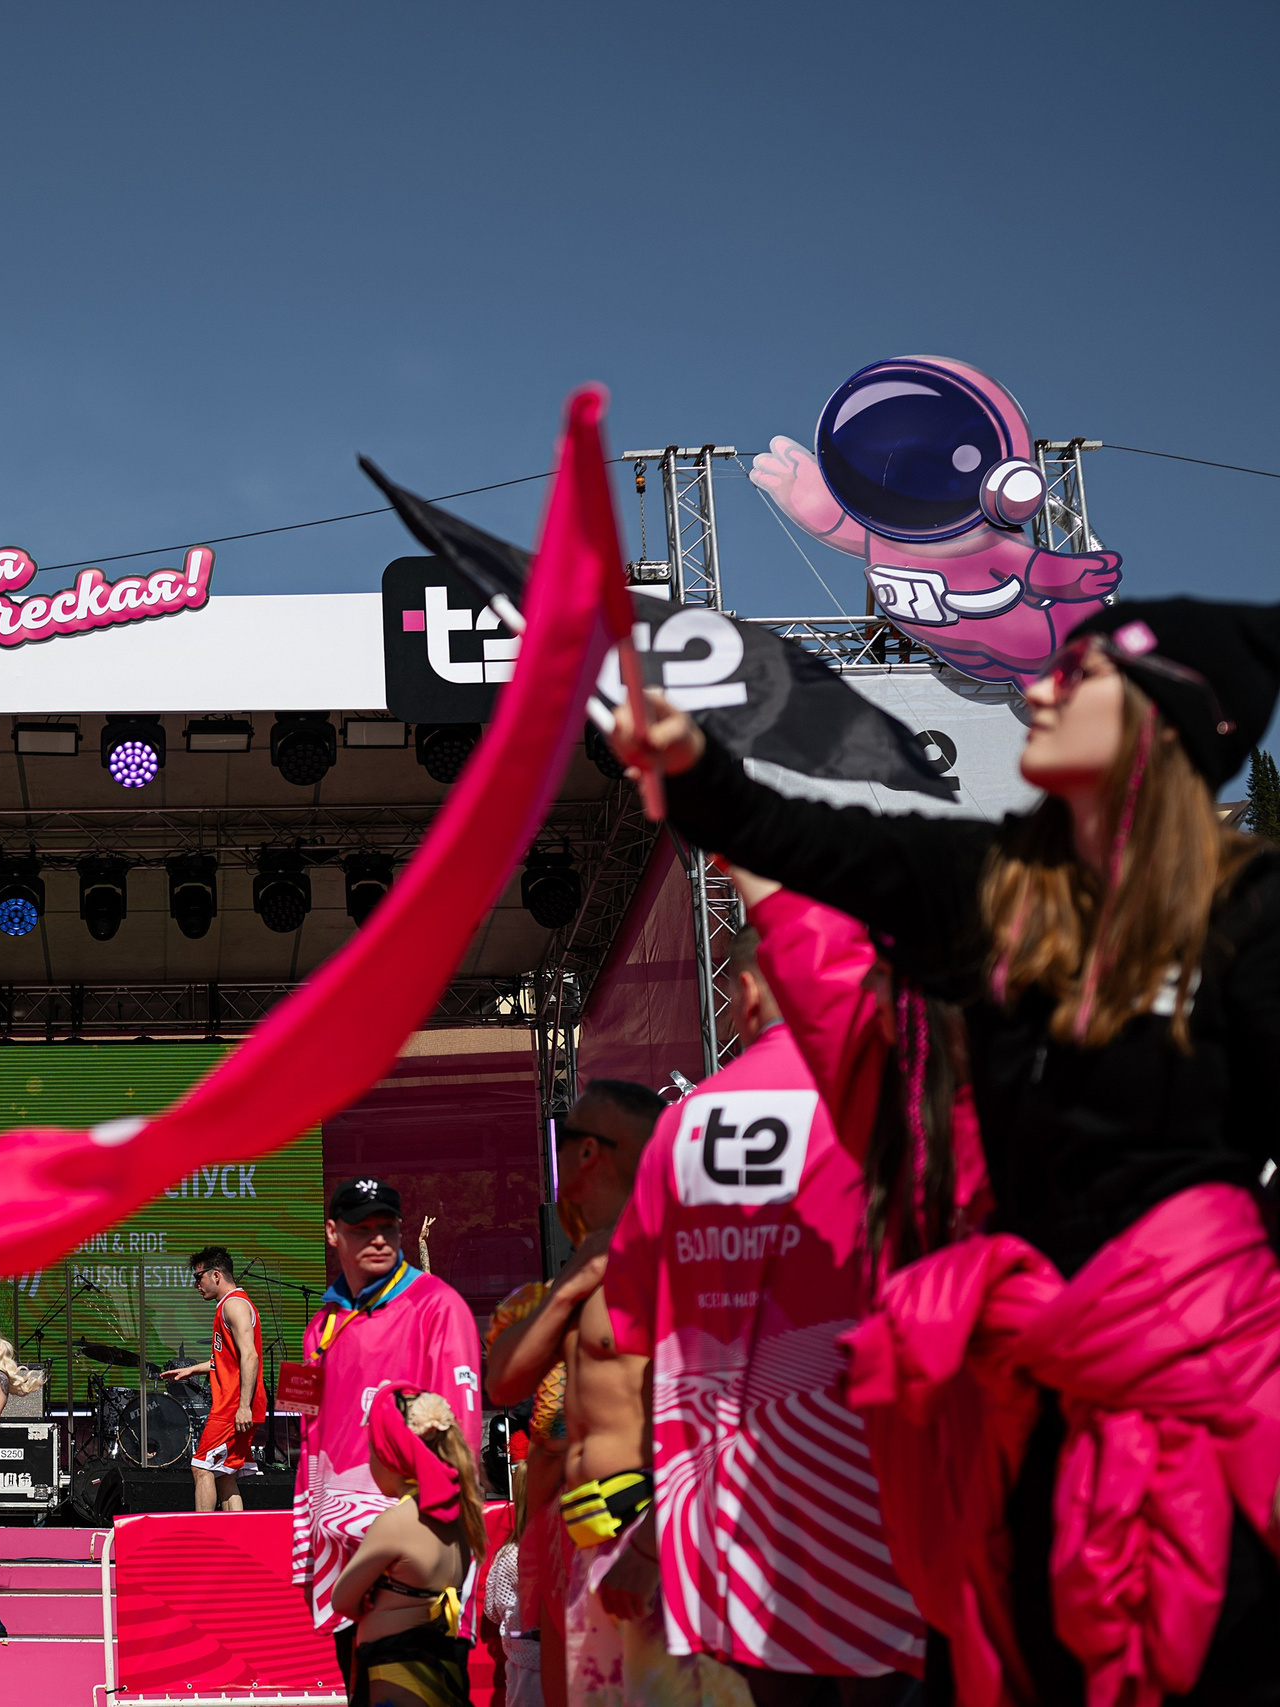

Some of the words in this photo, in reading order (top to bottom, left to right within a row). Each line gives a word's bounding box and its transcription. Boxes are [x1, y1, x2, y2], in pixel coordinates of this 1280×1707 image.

[690, 1106, 789, 1186] t2
[111, 1233, 125, 1254] &
[129, 1232, 167, 1253] RIDE
[73, 1266, 128, 1287] MUSIC
[0, 1450, 23, 1459] S250
